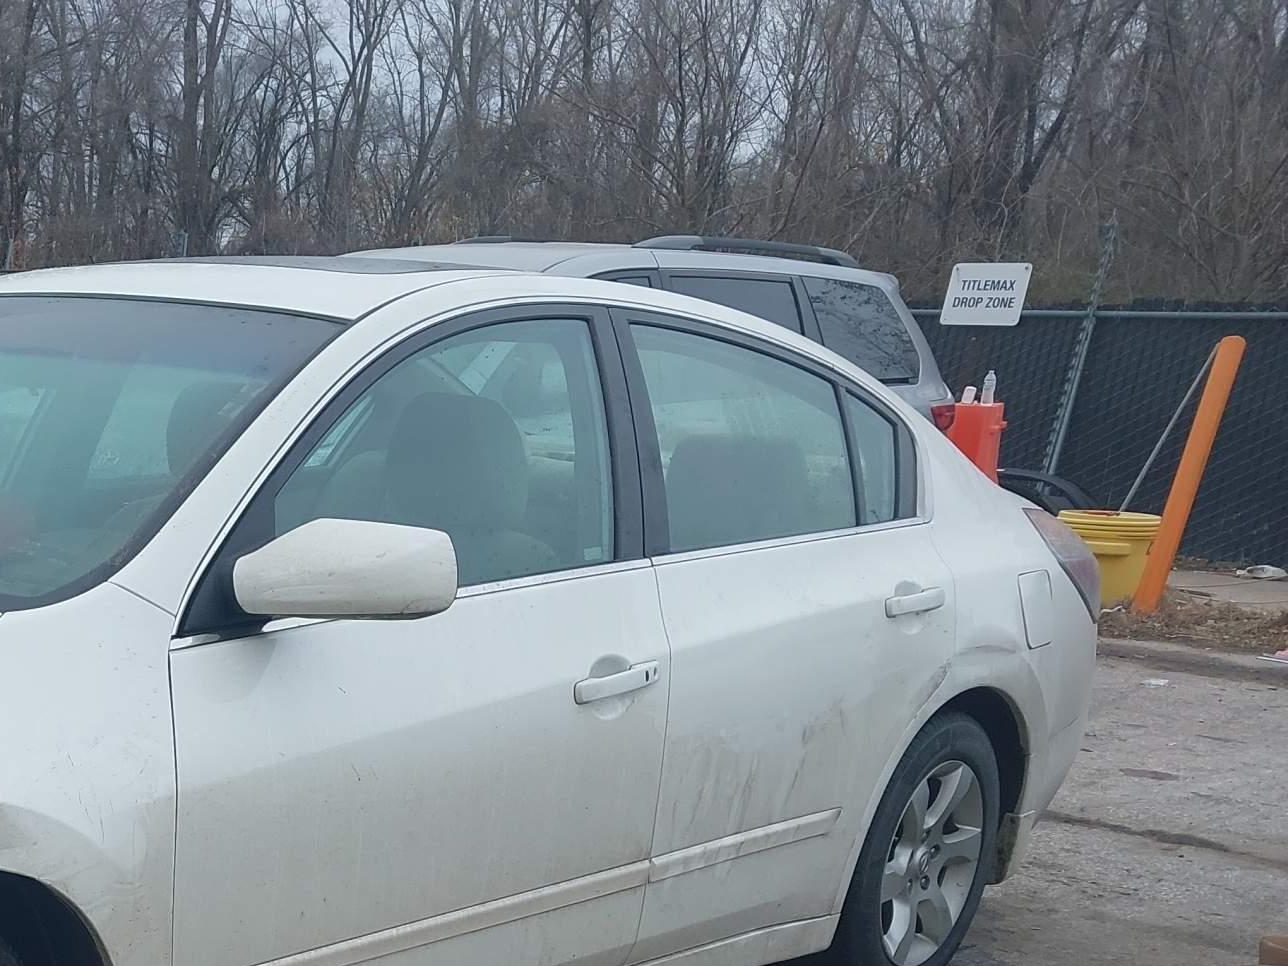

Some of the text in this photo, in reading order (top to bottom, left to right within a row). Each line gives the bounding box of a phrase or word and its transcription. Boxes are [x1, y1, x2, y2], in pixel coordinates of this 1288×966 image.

[961, 279, 1016, 291] TITLEMAX
[952, 297, 1016, 308] DROP ZONE
